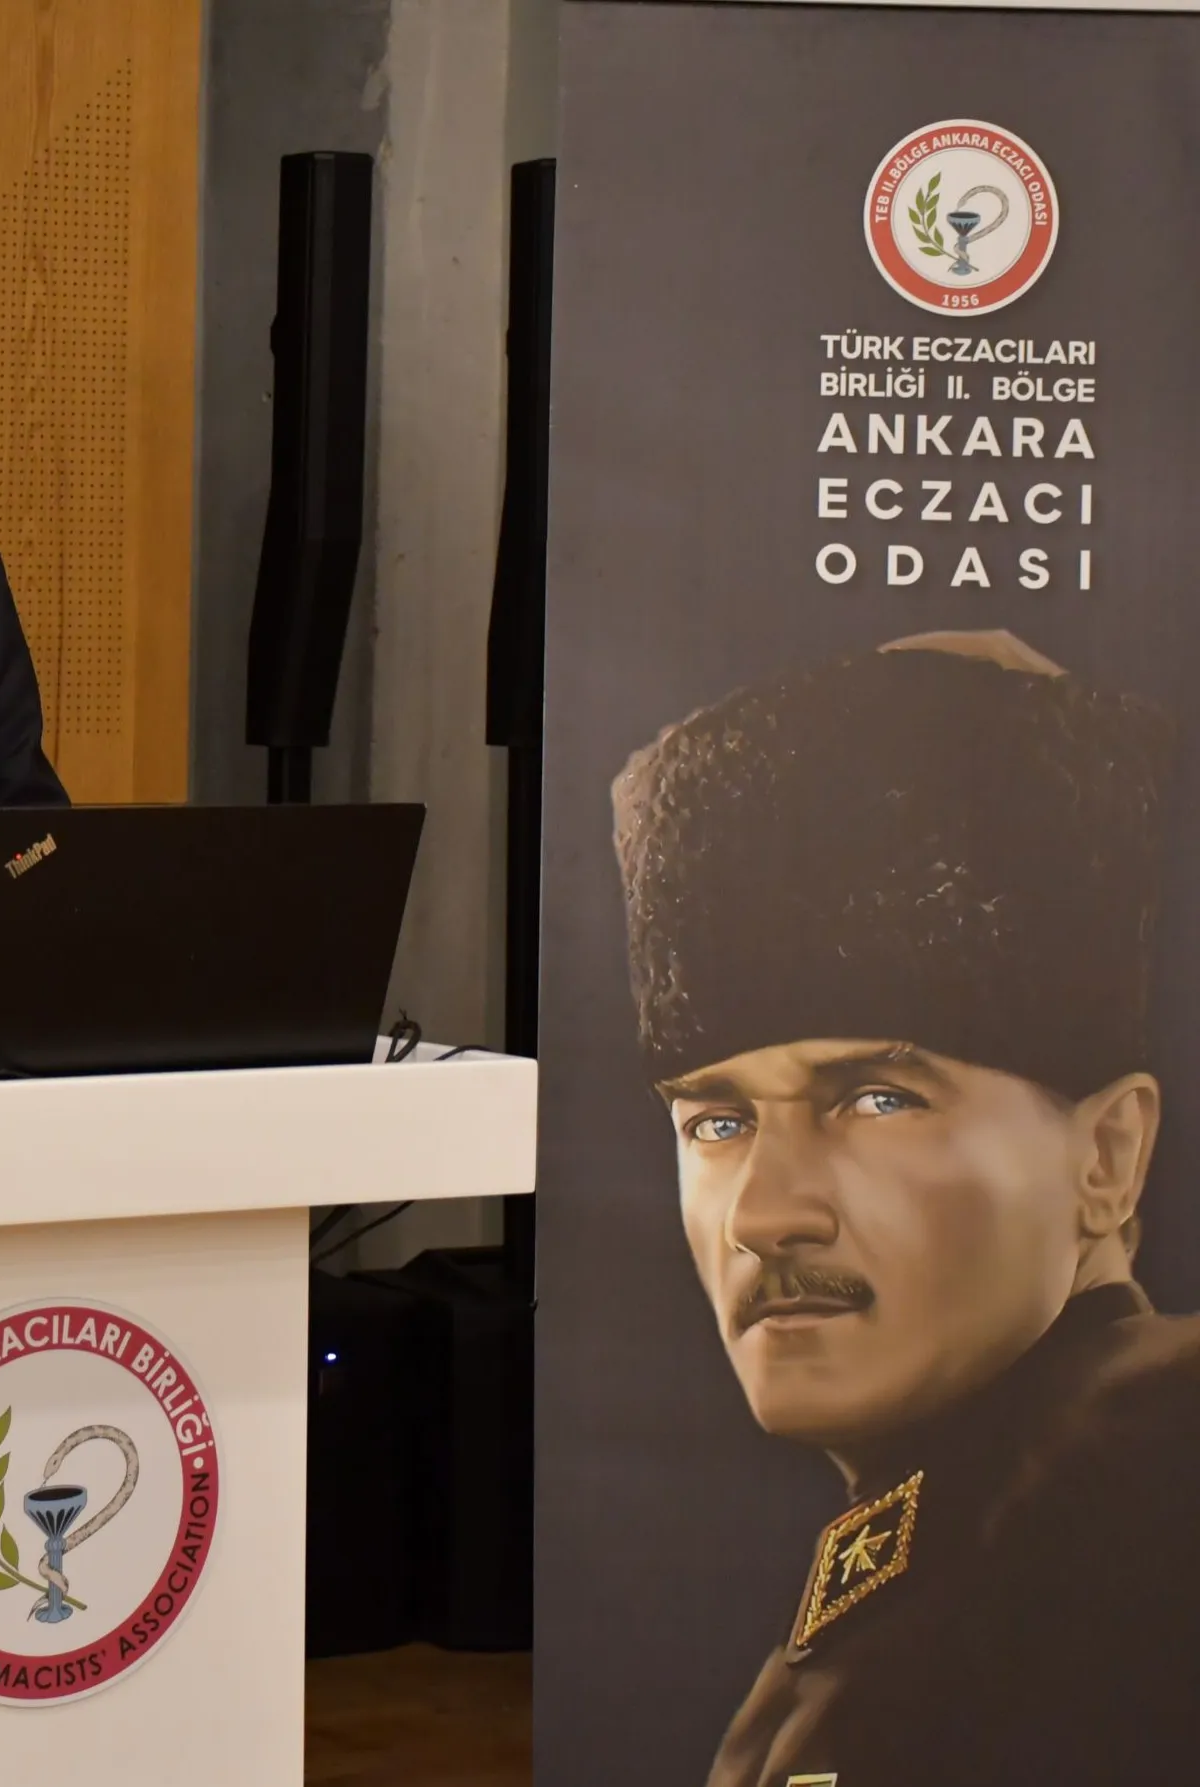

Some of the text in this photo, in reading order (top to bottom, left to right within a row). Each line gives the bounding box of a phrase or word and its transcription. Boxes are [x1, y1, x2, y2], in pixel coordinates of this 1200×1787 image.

[875, 194, 890, 223] TEB
[932, 132, 989, 150] ANKARA
[991, 141, 1035, 181] ECZACI
[1028, 181, 1048, 226] ODASI
[941, 294, 979, 308] 1956
[820, 328, 1095, 365] TÜRK ECZACILARI
[820, 366, 1095, 402] BİRLİĞİ II. BÖLGE
[817, 412, 1095, 459] ANKARA
[818, 478, 1092, 525] ECZACI
[815, 543, 1091, 590] ODASI
[4, 832, 57, 879] ThinkPad
[130, 1347, 214, 1457] BİRLİĞİ
[118, 1471, 210, 1661] ASSOCIATION
